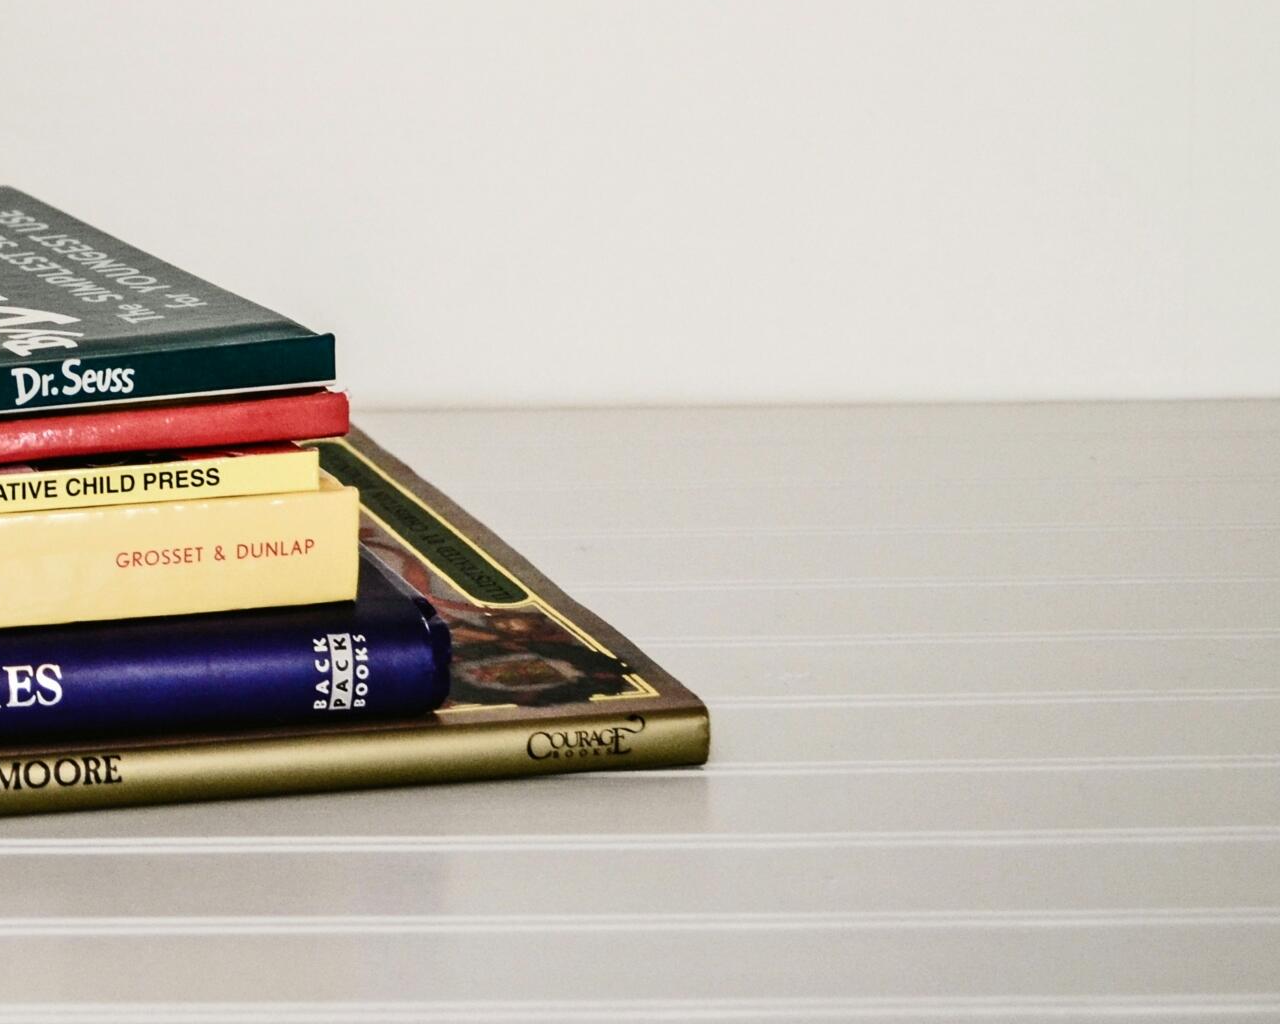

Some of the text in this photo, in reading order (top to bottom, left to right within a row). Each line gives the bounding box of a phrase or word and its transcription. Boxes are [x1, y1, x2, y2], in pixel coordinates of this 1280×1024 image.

[28, 234, 171, 293] YOUNGEST
[116, 303, 165, 325] The
[164, 293, 208, 309] for
[11, 359, 135, 406] Dr. Seuss
[65, 474, 136, 497] CHILD
[143, 467, 221, 491] PRESS
[116, 539, 316, 569] GROSSET & DUNLAP
[313, 636, 328, 710] BACK
[332, 636, 349, 708] PACK
[354, 633, 370, 707] BOOKS
[526, 714, 646, 760] COURAGE
